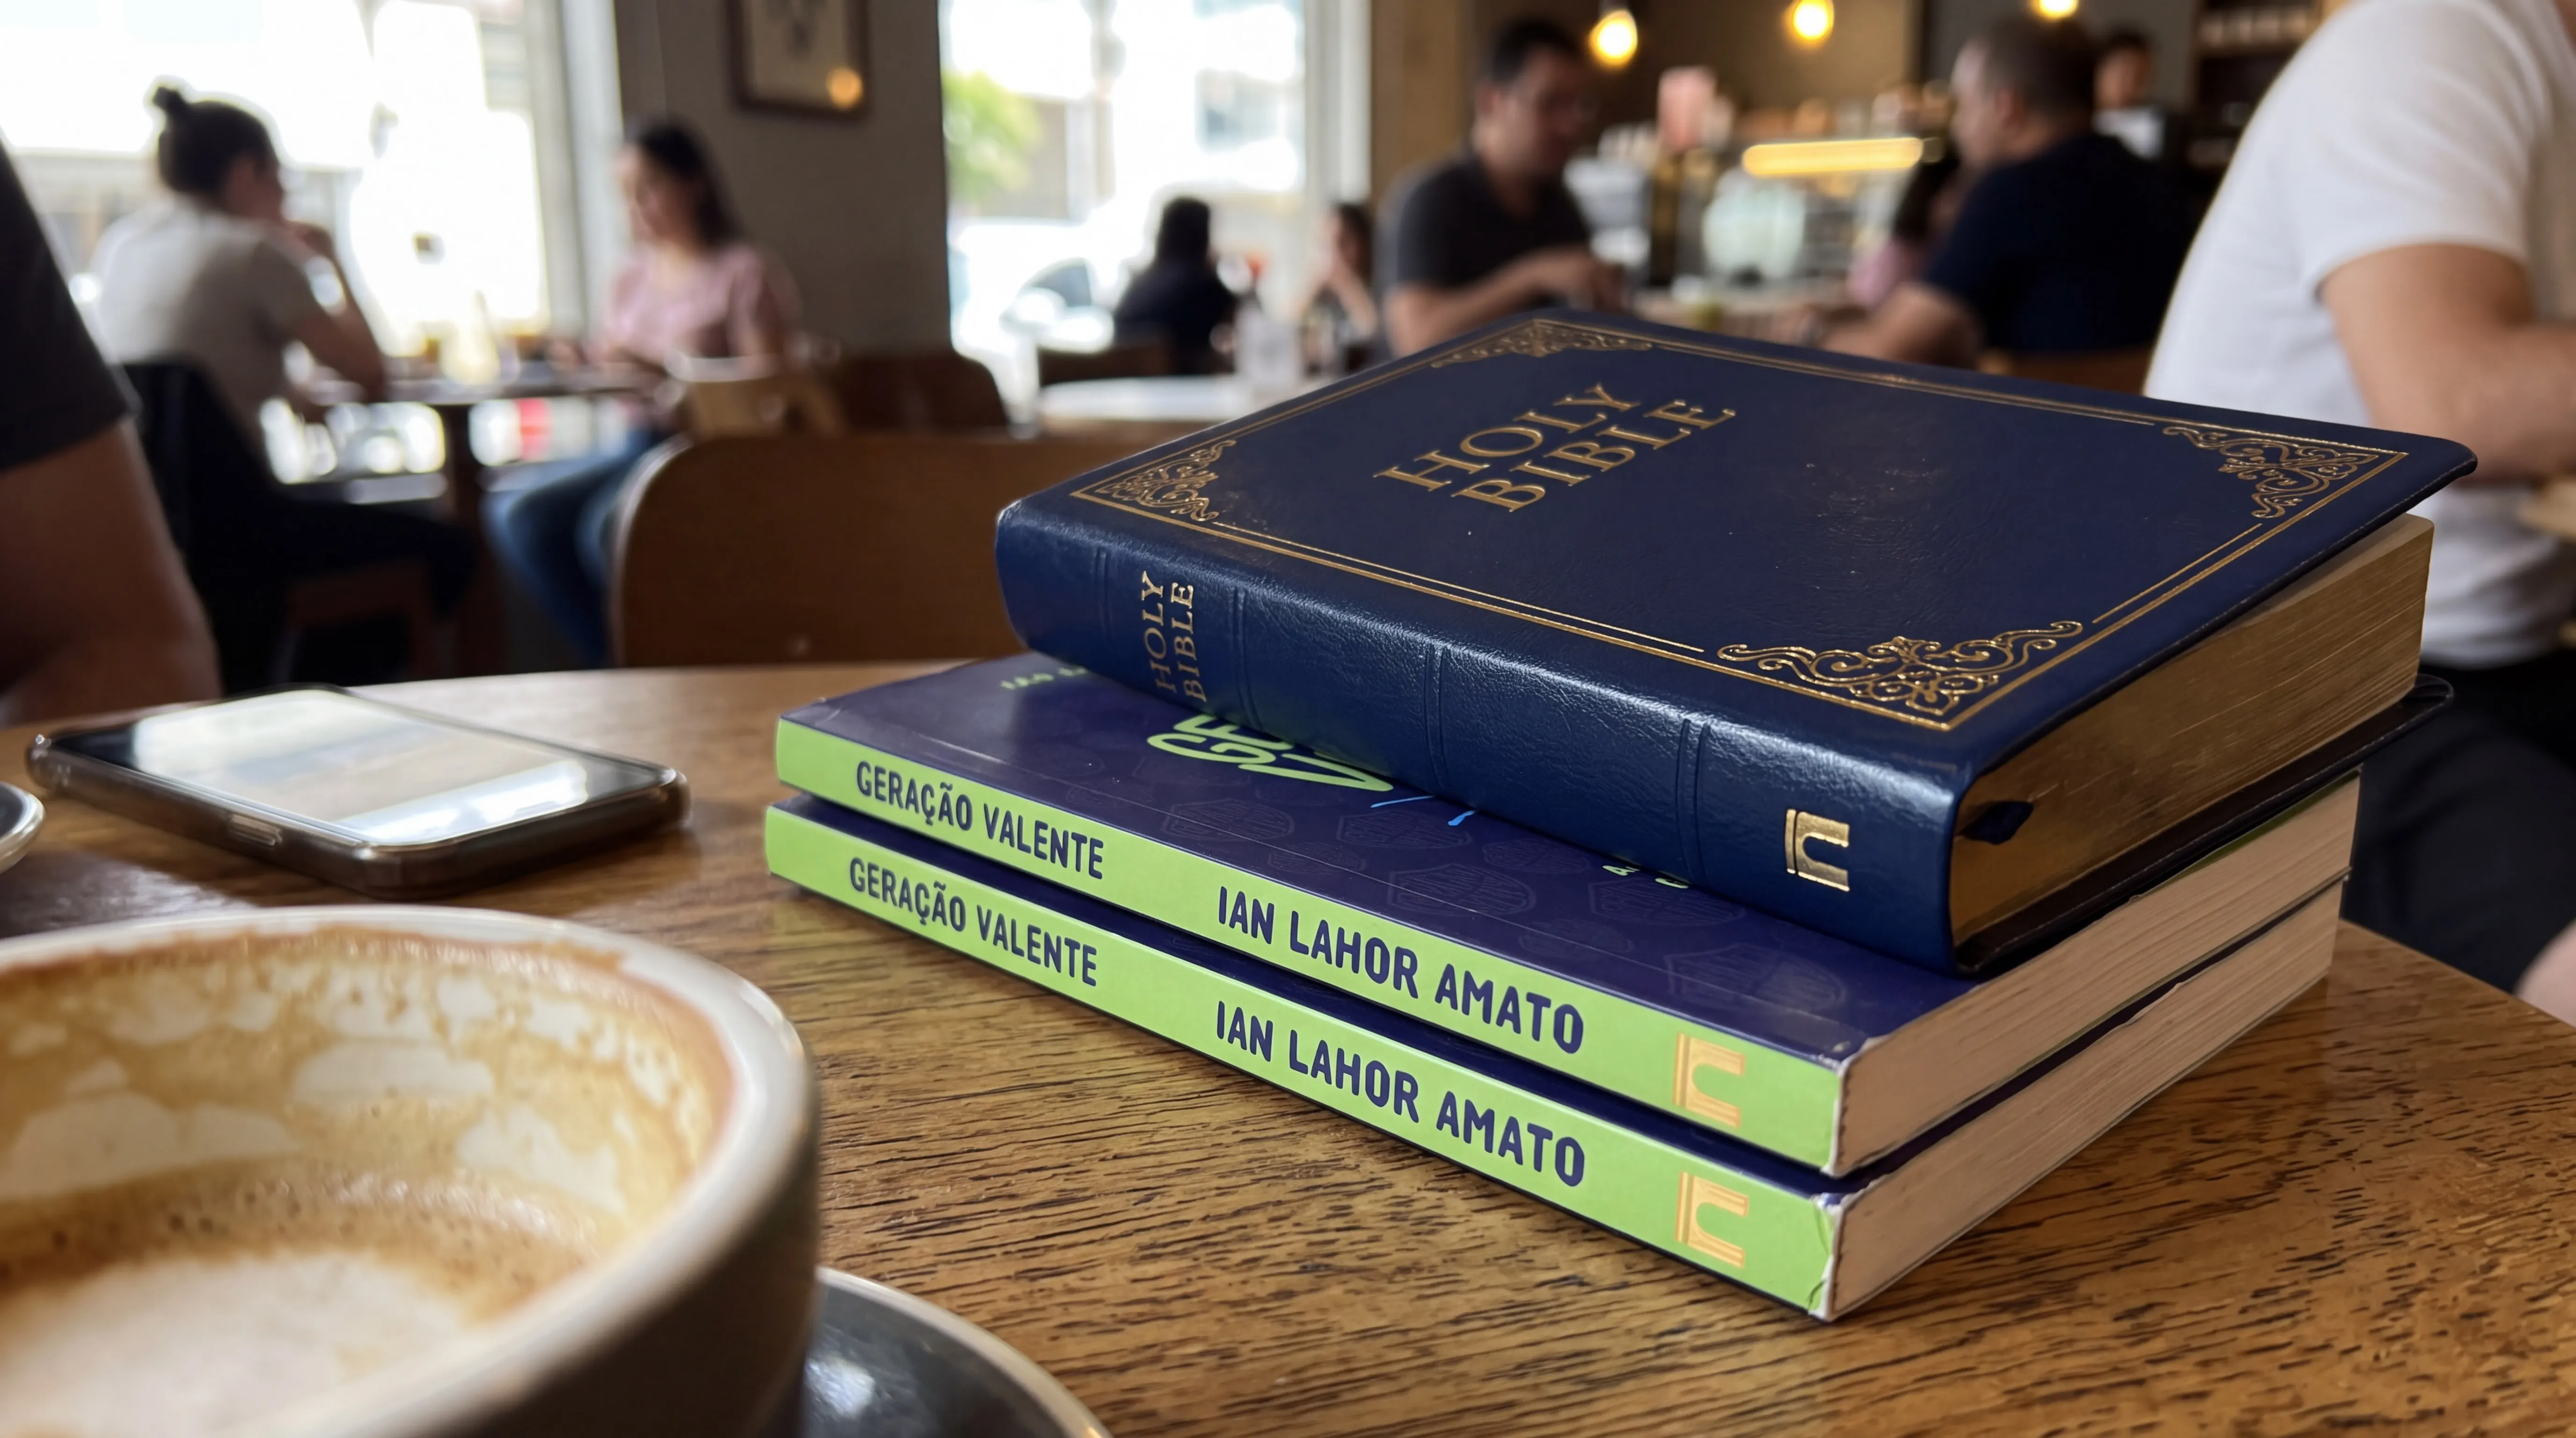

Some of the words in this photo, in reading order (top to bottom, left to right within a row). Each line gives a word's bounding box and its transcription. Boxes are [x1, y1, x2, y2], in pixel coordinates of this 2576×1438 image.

[1373, 383, 1641, 492] HOLY
[1451, 399, 1737, 513] BIBLE
[1141, 570, 1178, 694] HOLY
[1171, 582, 1208, 703] BIBLE
[857, 762, 973, 831] GERAÇÃO
[984, 803, 1104, 880] VALENTE
[849, 858, 966, 932] GERAÇÃO
[977, 905, 1097, 987] VALENTE
[1219, 886, 1274, 945] IAN
[1290, 910, 1419, 999] LAHOR
[1434, 963, 1584, 1054] AMATO
[1217, 1001, 1273, 1062] IAN
[1289, 1029, 1420, 1123] LAHOR
[1436, 1091, 1585, 1187] AMATO
